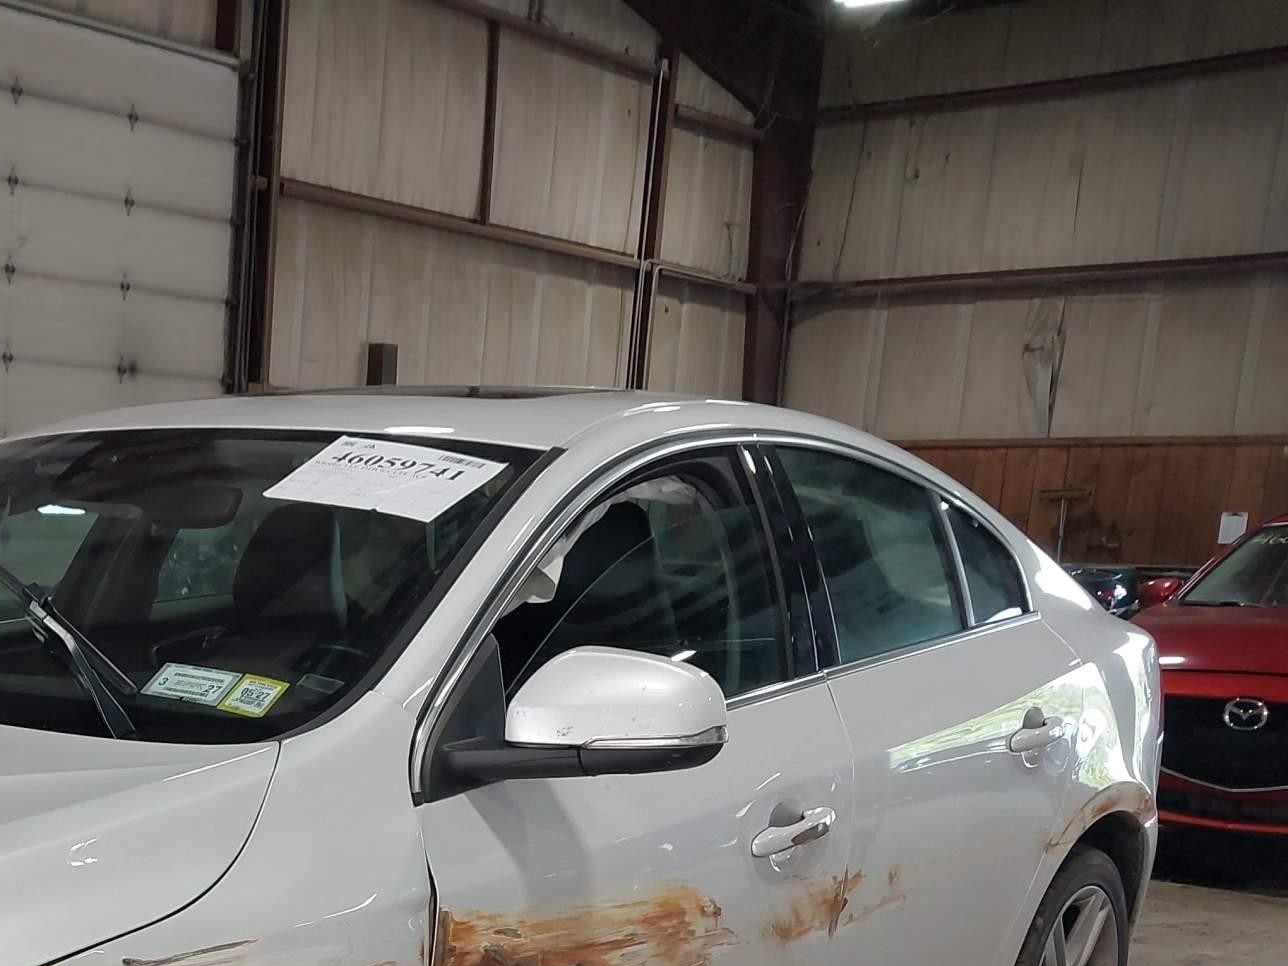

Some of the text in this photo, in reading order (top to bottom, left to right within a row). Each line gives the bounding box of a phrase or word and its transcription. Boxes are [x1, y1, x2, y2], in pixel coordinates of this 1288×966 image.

[331, 451, 466, 481] 46059741
[158, 677, 169, 686] 3
[203, 684, 224, 695] 27
